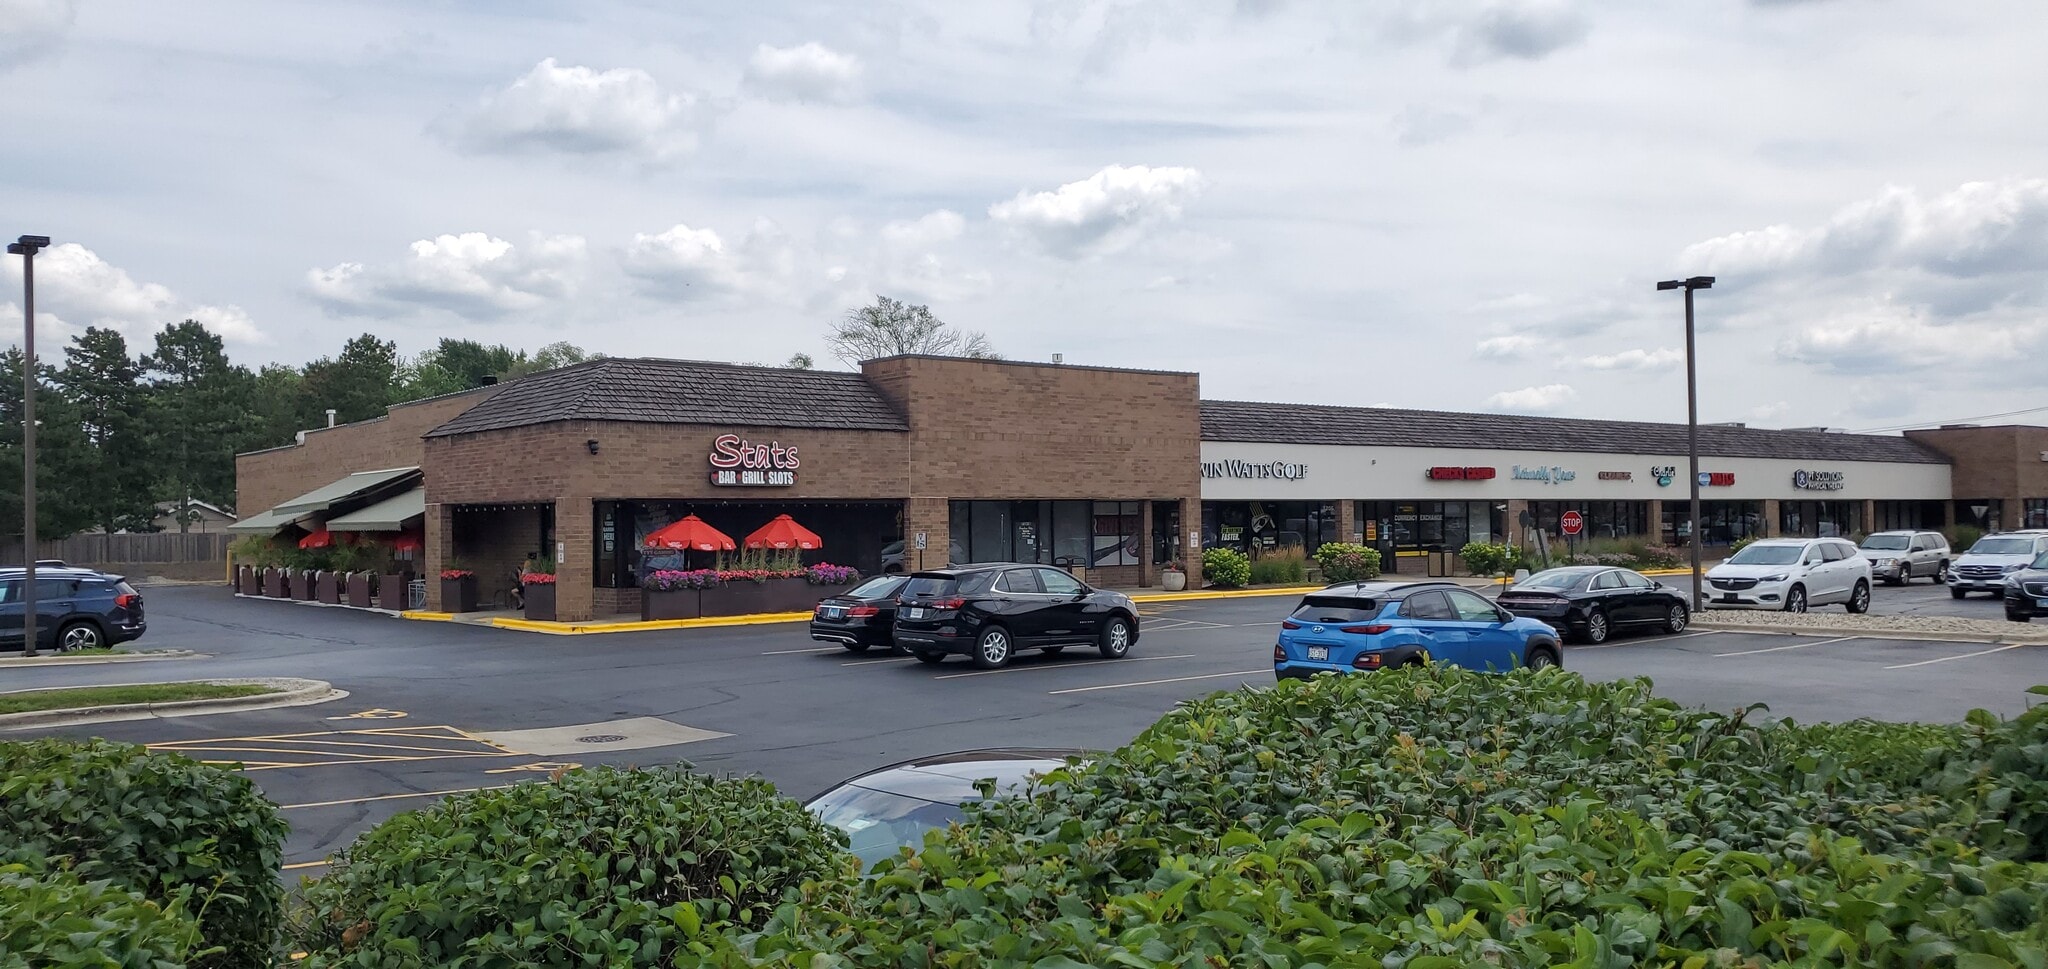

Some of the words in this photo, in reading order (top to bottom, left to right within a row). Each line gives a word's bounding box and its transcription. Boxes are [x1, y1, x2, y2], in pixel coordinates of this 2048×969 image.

[709, 433, 800, 470] Stats
[718, 471, 737, 484] BAR
[741, 471, 765, 485] GRILL
[768, 471, 794, 485] SLOTS
[1563, 518, 1581, 527] STOP
